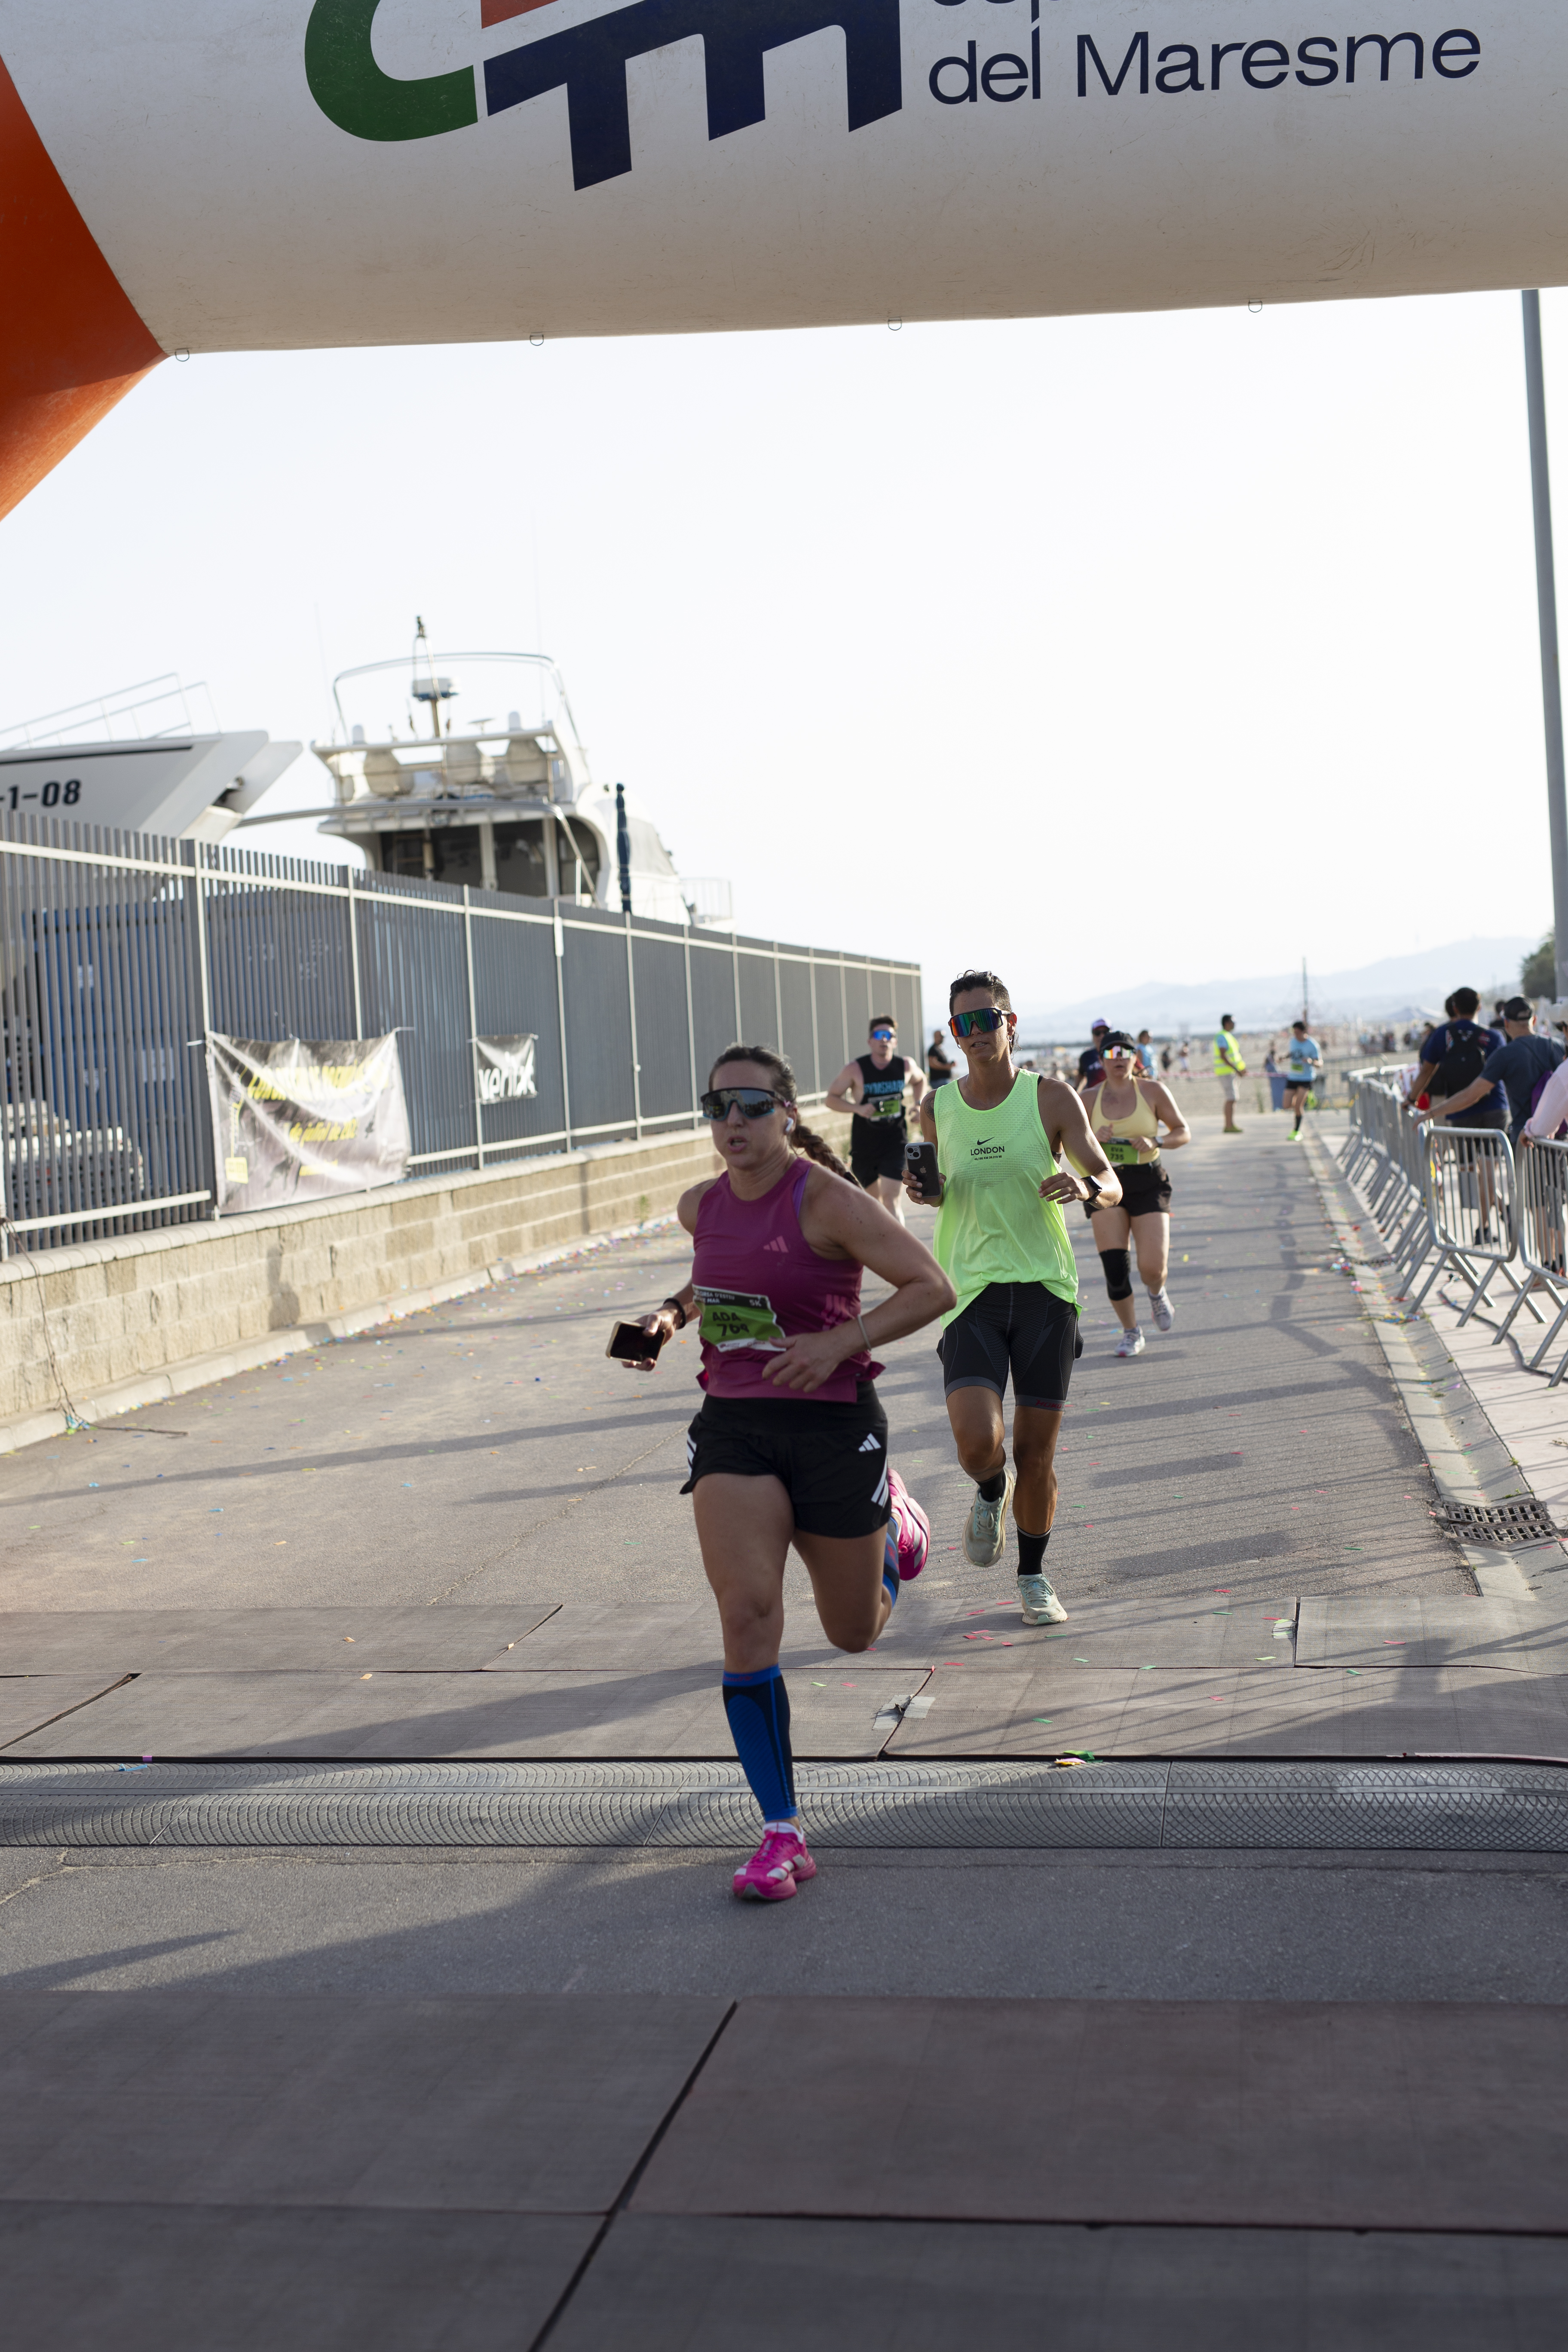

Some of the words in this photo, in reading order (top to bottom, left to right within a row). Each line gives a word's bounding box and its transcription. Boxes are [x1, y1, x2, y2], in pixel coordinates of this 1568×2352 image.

[928, 25, 1041, 104] del
[1077, 28, 1481, 98] Maresme
[0, 779, 81, 809] 1-08
[971, 1146, 1005, 1156] LONDON
[749, 1298, 763, 1307] 5K
[712, 1311, 741, 1322] ADA
